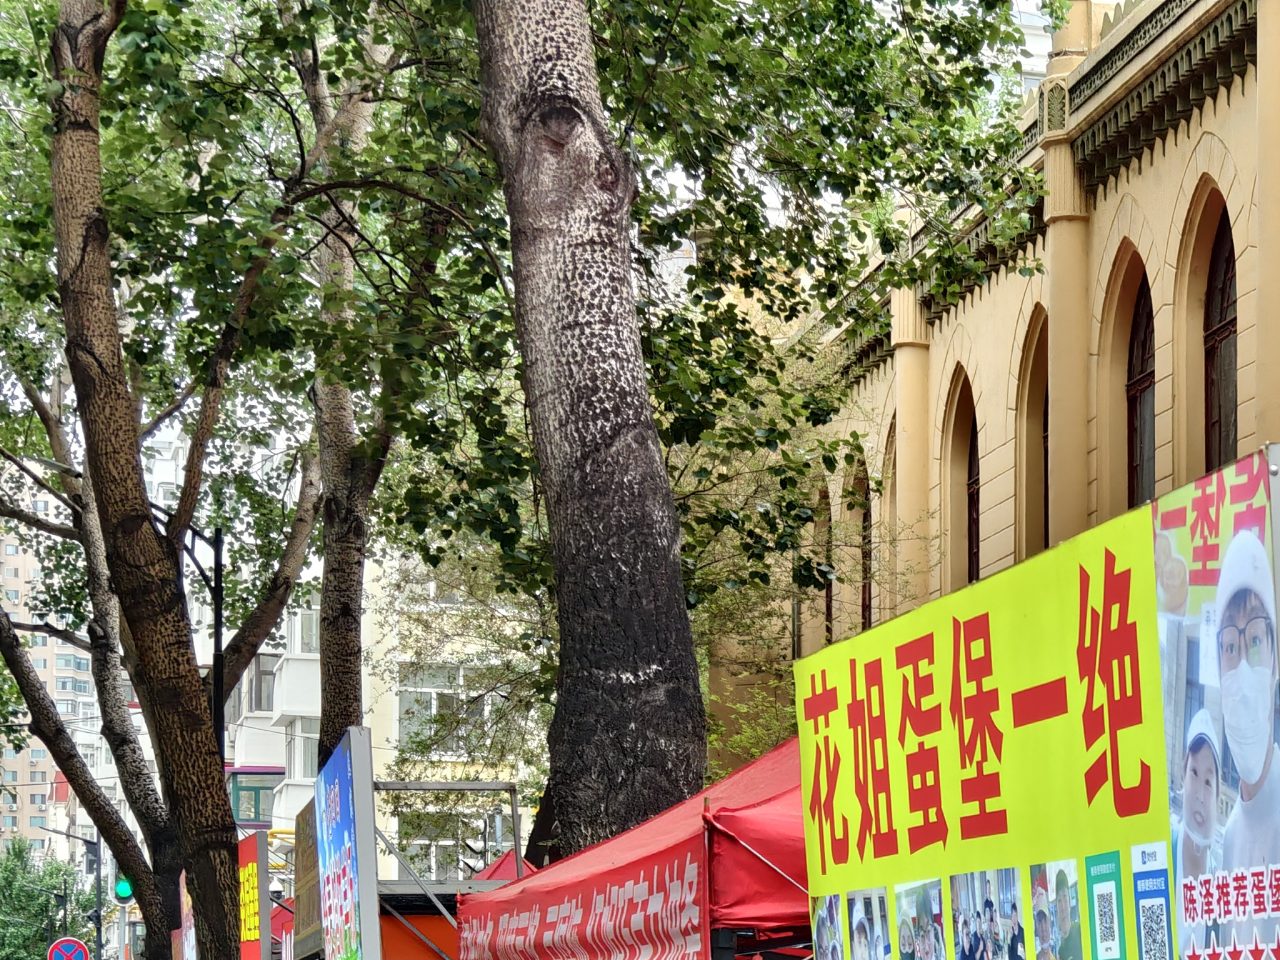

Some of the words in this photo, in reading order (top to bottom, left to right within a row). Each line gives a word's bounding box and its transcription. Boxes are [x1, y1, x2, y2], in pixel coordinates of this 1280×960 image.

[802, 546, 1152, 876] 花姐蛋堡一绝
